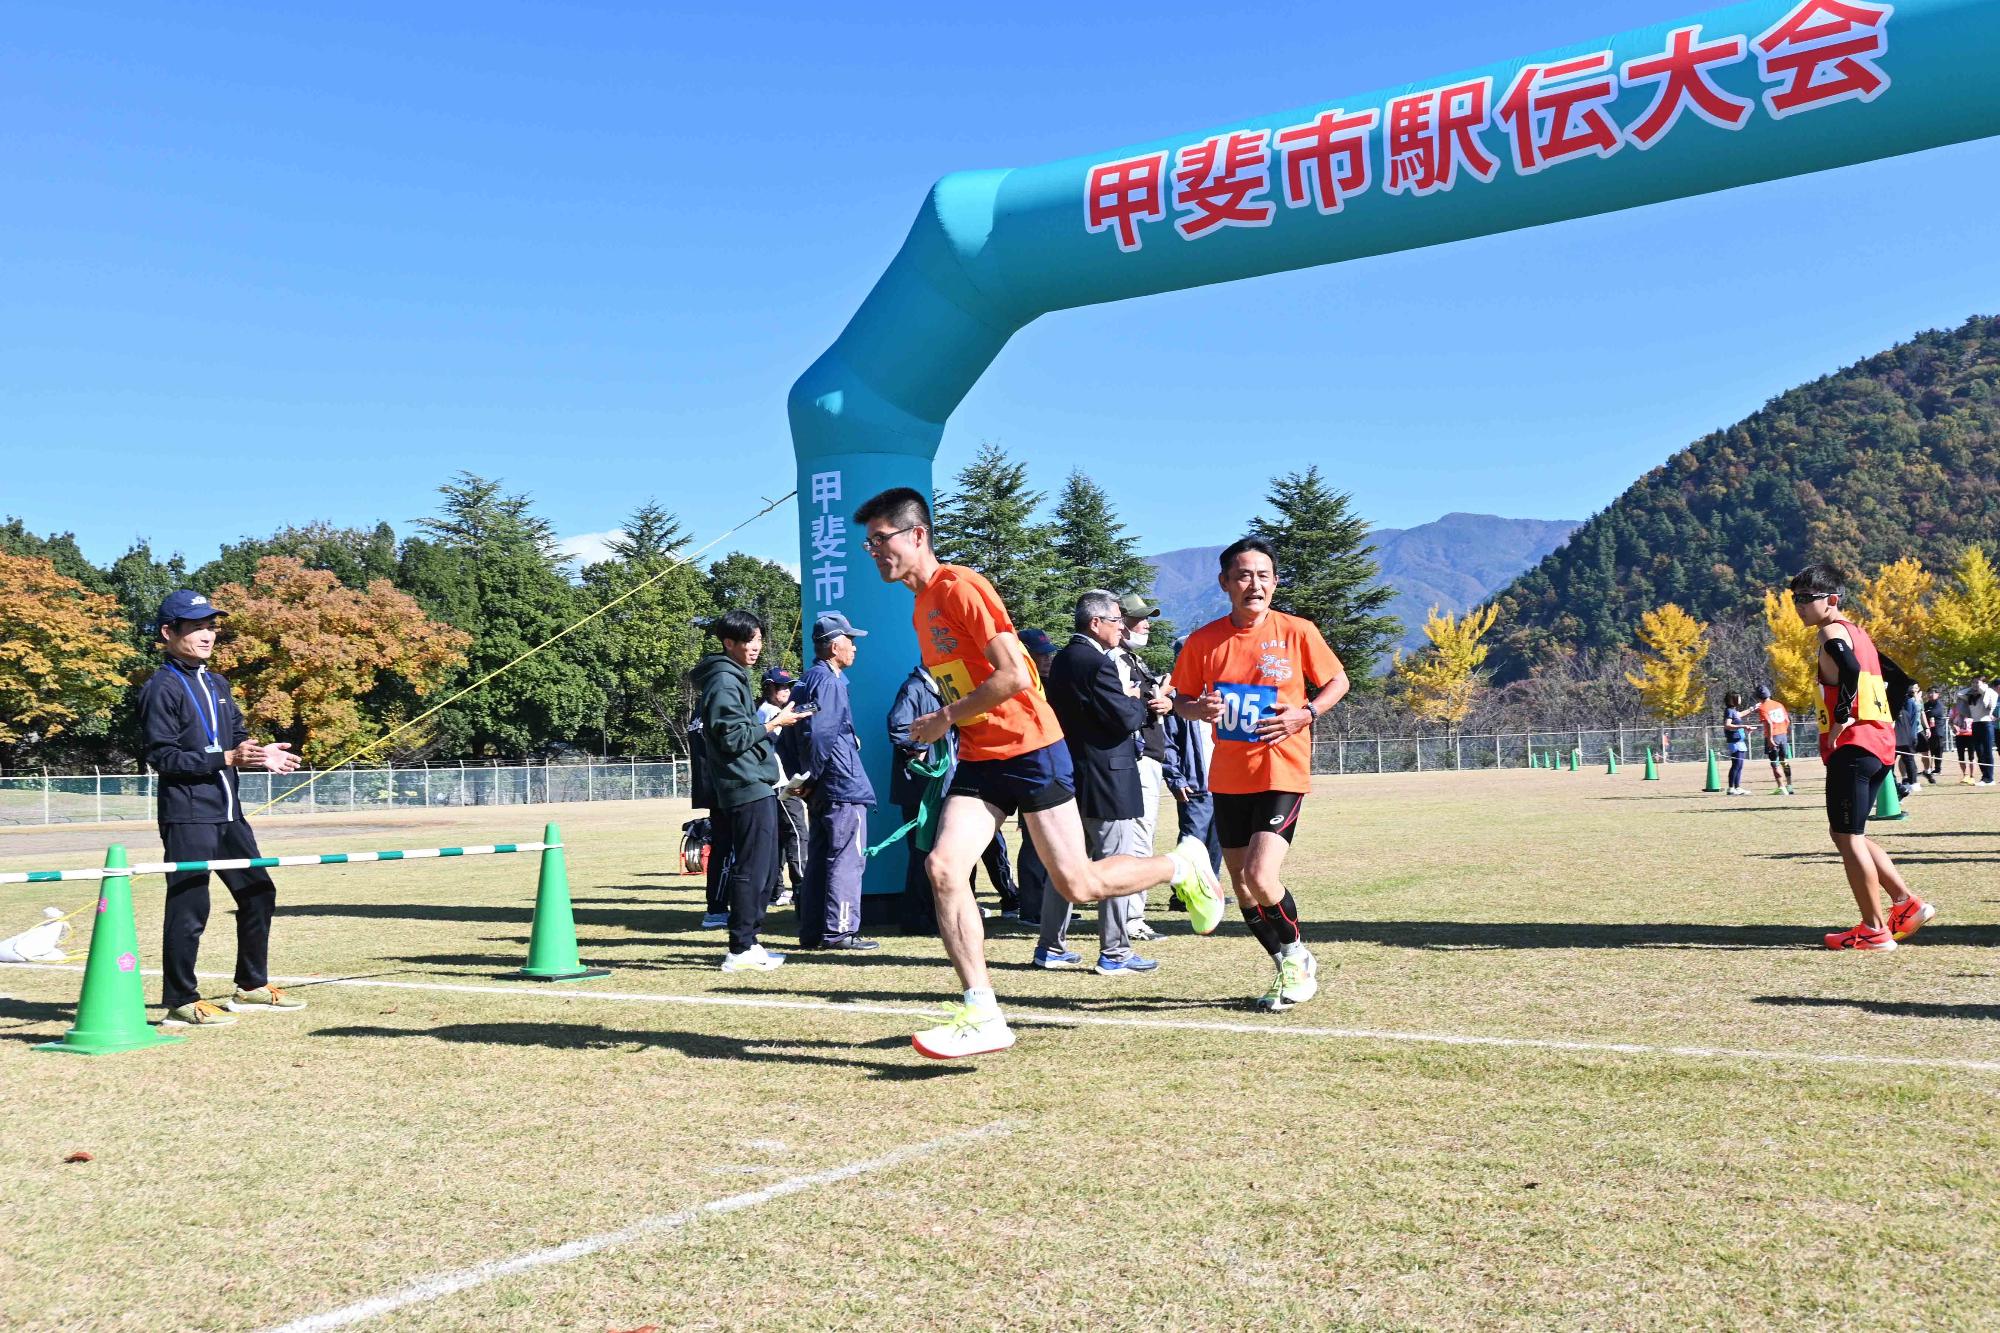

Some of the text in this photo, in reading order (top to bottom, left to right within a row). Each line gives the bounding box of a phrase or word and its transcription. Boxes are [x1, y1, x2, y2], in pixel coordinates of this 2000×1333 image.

[1085, 0, 1894, 252] 甲斐市駅伝大会
[811, 471, 848, 618] 甲斐市
